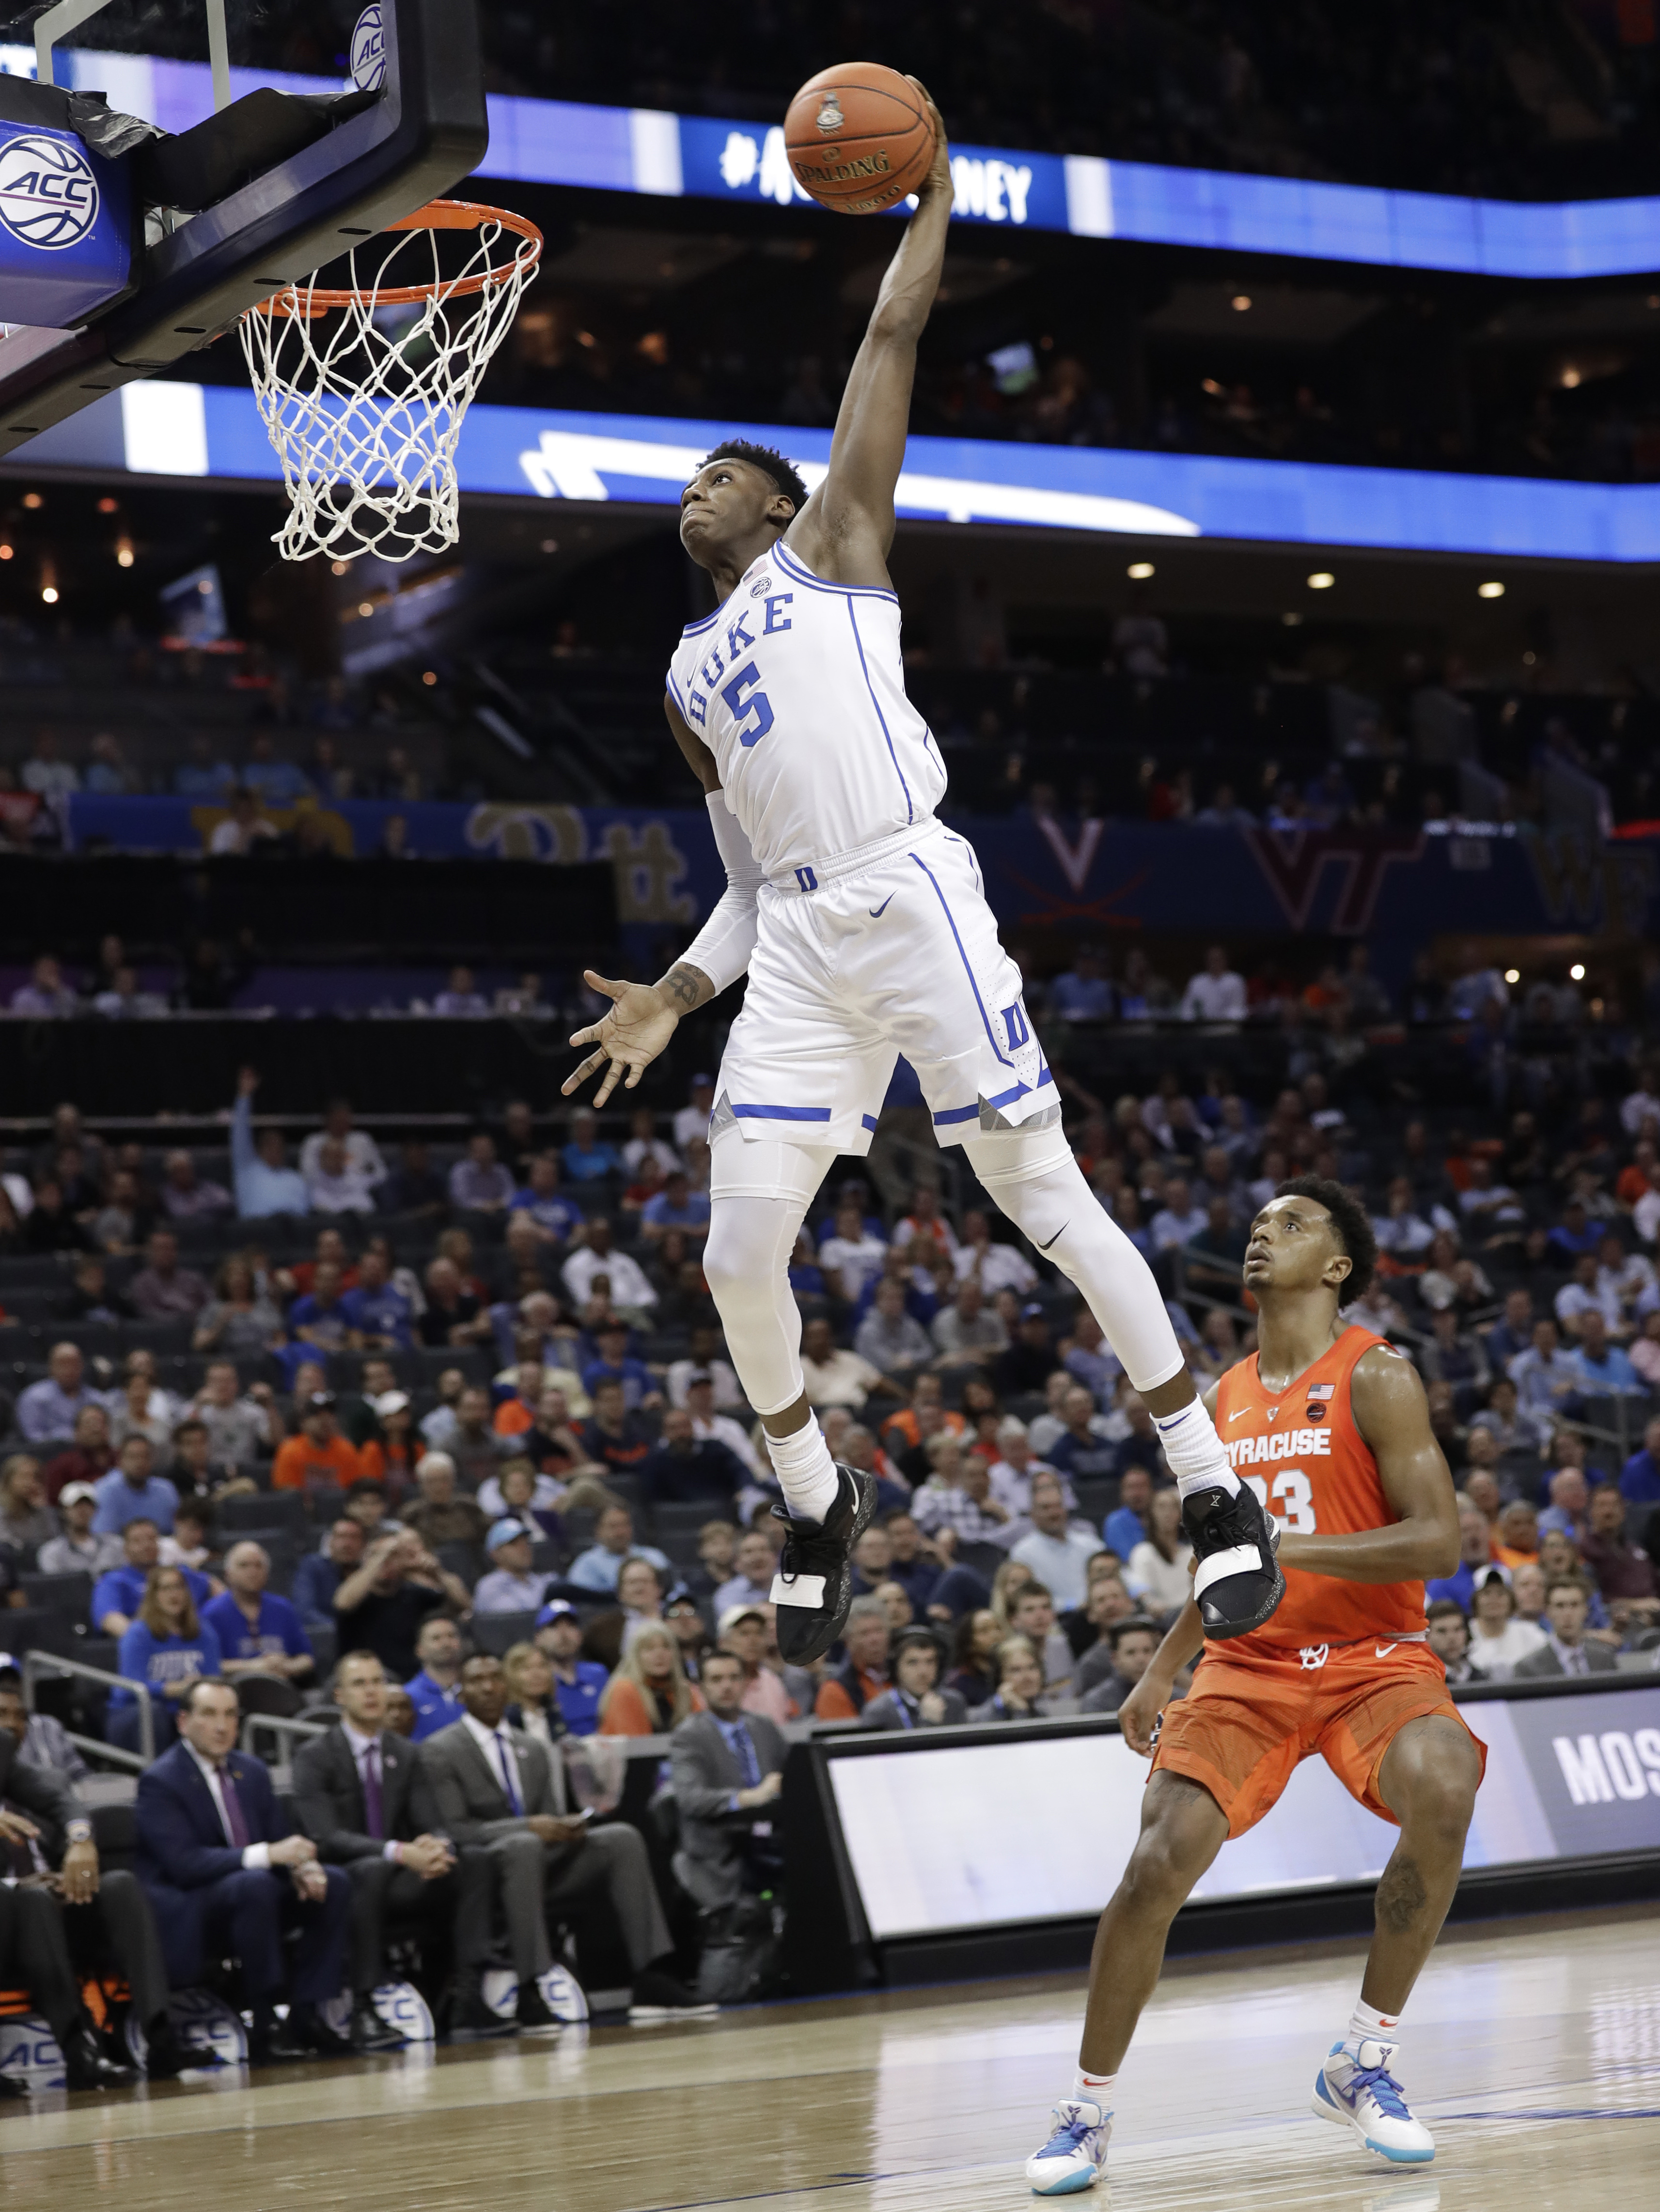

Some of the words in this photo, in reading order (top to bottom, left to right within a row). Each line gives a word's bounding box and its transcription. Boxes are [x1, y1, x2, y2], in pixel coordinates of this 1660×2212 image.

[795, 149, 891, 182] SPALDING
[2, 171, 94, 203] ACC
[690, 593, 793, 727] DUKE
[721, 660, 774, 747] 5
[794, 867, 818, 892] D
[0, 2042, 59, 2069] AC
